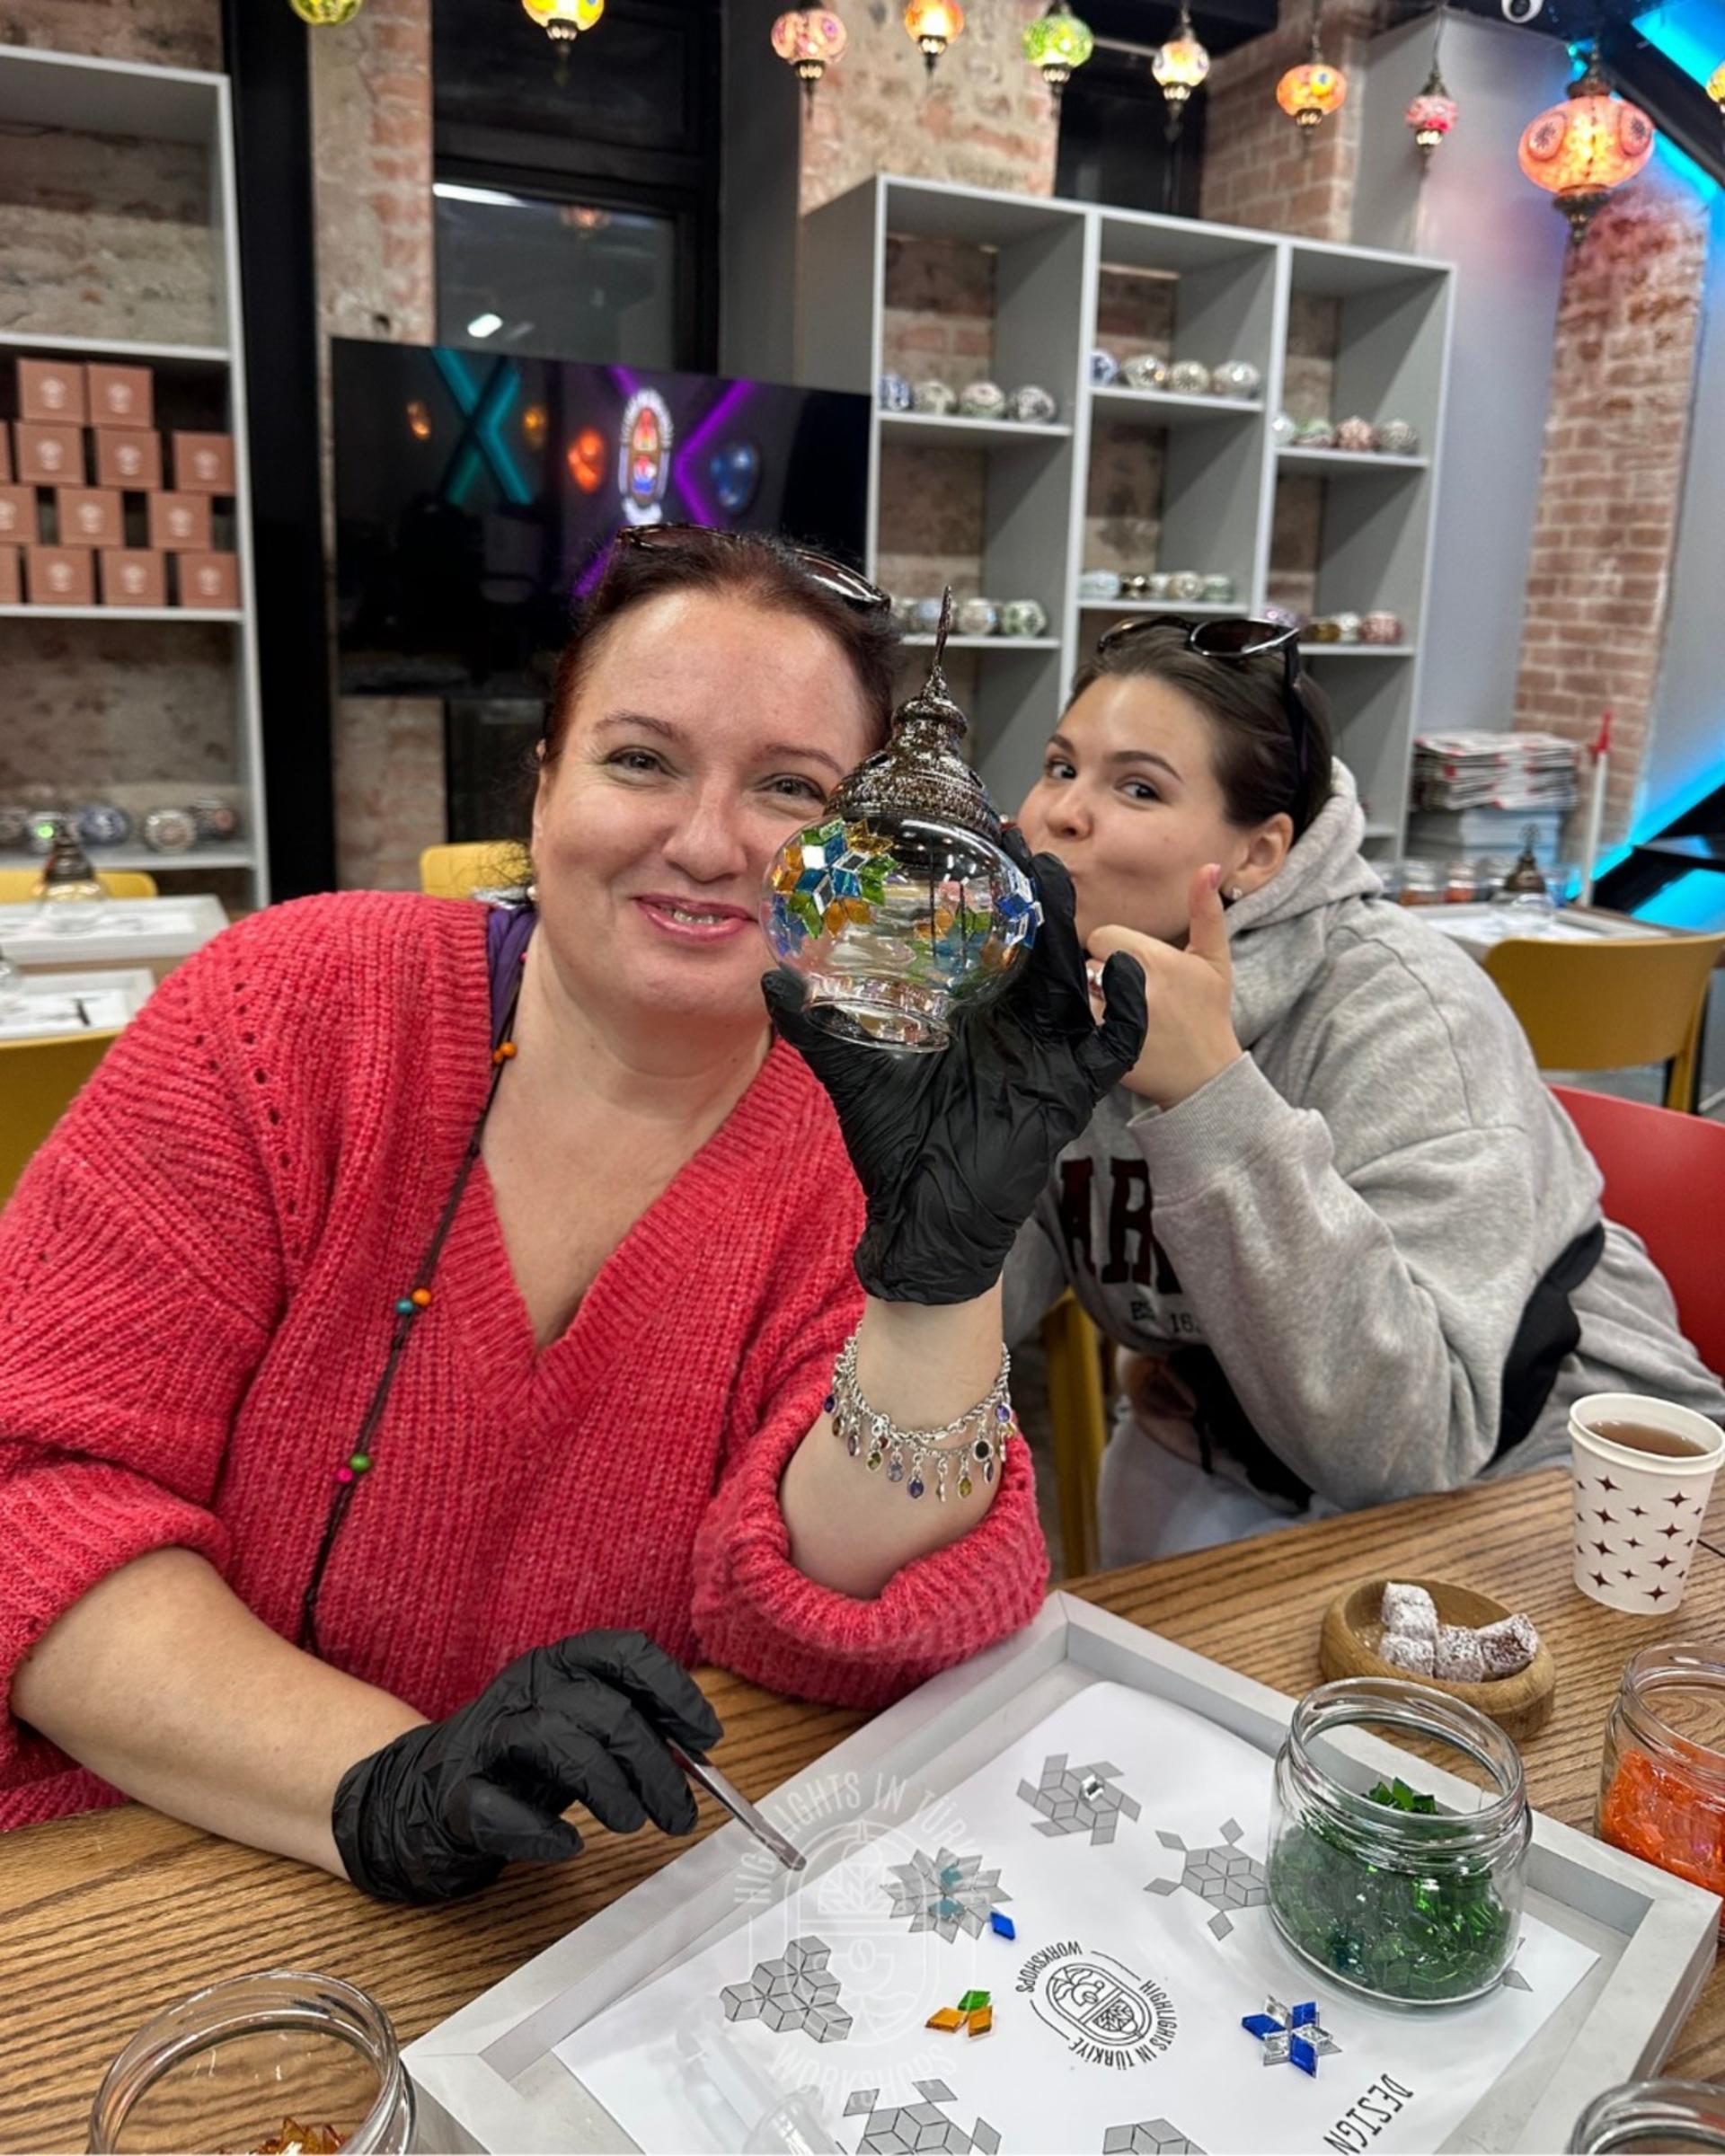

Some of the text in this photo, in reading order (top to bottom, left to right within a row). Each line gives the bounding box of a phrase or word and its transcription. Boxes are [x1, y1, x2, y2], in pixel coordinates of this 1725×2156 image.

[1015, 1940, 1083, 1993] WORKSHOPS
[1139, 1979, 1178, 2051] HIGHLIGHTS
[1135, 2044, 1157, 2063] IN
[1322, 2073, 1414, 2155] DESIGN
